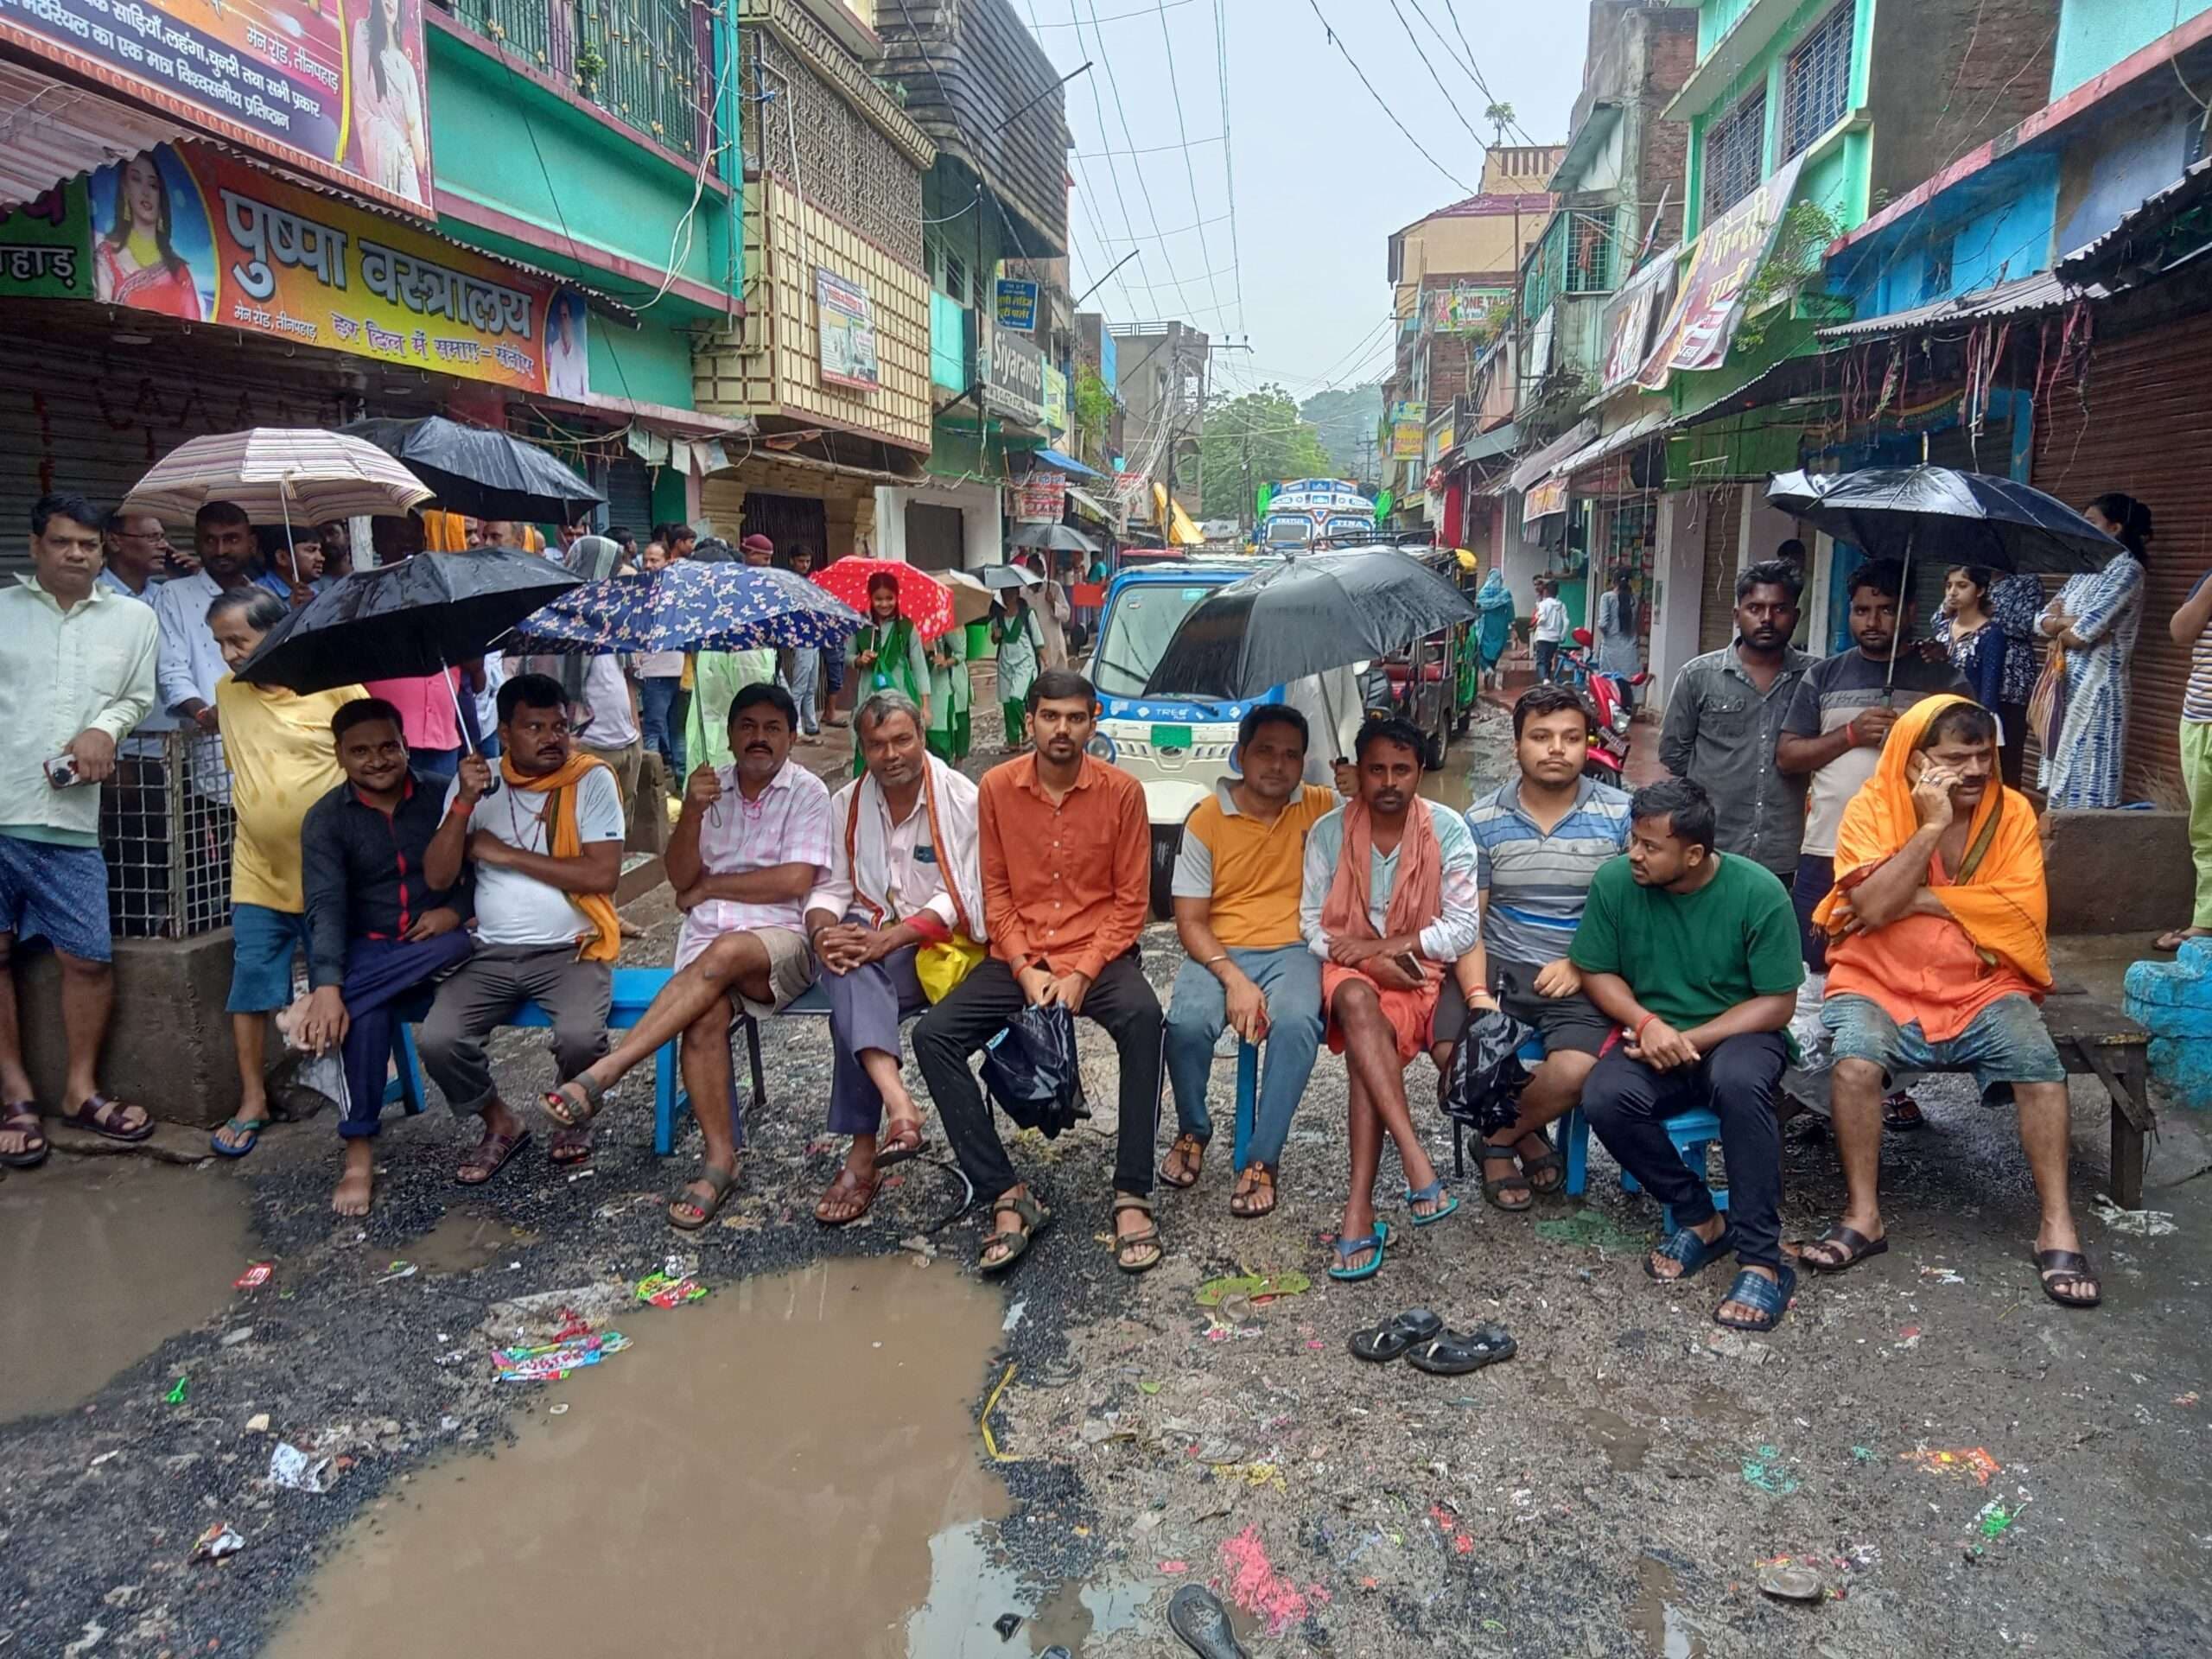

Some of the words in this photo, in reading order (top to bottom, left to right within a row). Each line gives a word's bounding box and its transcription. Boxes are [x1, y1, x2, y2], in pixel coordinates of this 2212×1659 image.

[92, 23, 114, 50] का
[117, 35, 143, 60] एक
[145, 49, 175, 77] मात्र
[176, 58, 242, 109] विश्वसनीय
[244, 95, 289, 130] प्रतिष्ठान
[293, 47, 339, 94] तीनपहाड़
[266, 79, 290, 104] सभी
[292, 92, 321, 118] प्रकार
[0, 246, 75, 287] हाड़
[219, 189, 348, 301] पुष्पा
[358, 238, 531, 339] वस्त्रालय
[234, 300, 251, 321] मेन
[331, 312, 360, 344] हर
[365, 321, 406, 358] दिल
[411, 328, 429, 359] में
